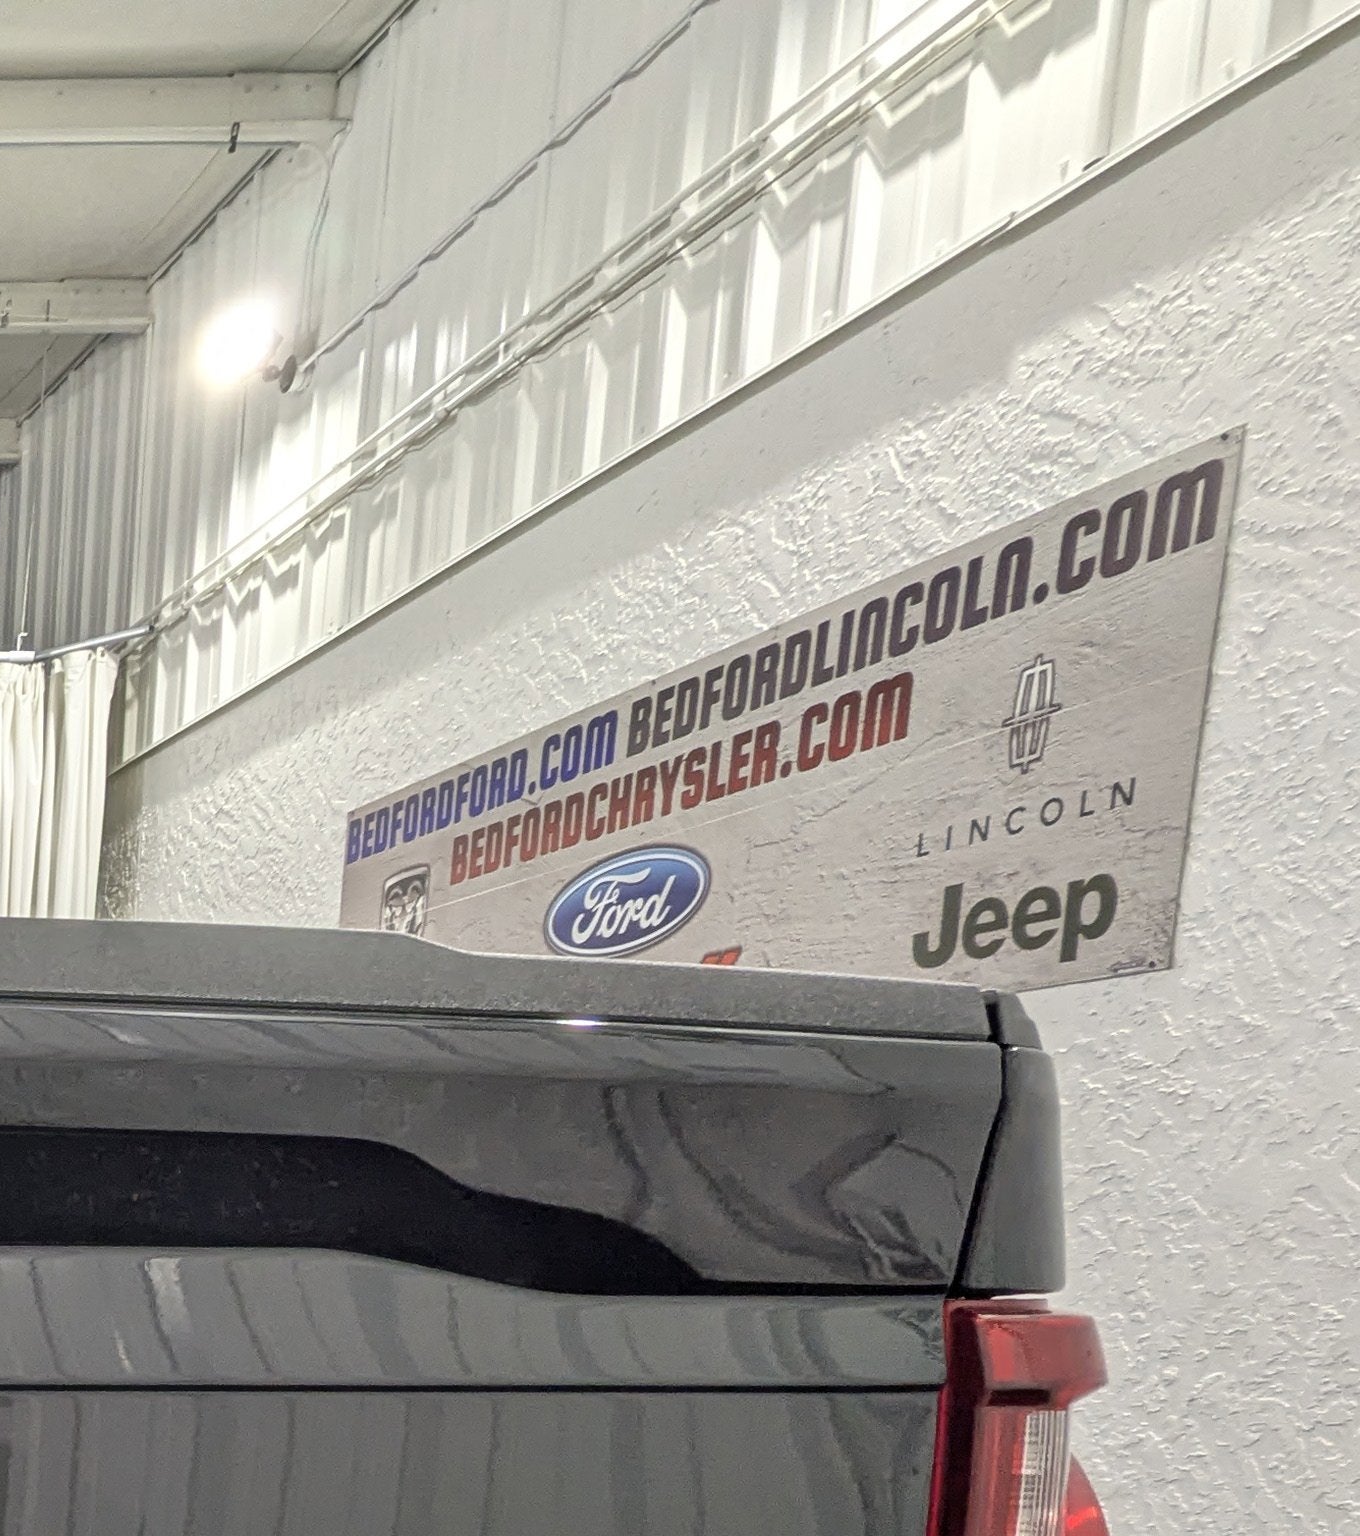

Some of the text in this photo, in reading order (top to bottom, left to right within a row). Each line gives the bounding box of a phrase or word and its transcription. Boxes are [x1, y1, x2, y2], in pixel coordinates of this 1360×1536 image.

[346, 458, 1225, 865] BEDFORDFORD.COM BEDFORDLINCOLN.COM
[450, 671, 914, 886] BEDFORDCHRYSLER.COM
[916, 776, 1137, 858] LINCOLN
[570, 867, 677, 945] Ford
[911, 872, 1119, 969] Jeep
